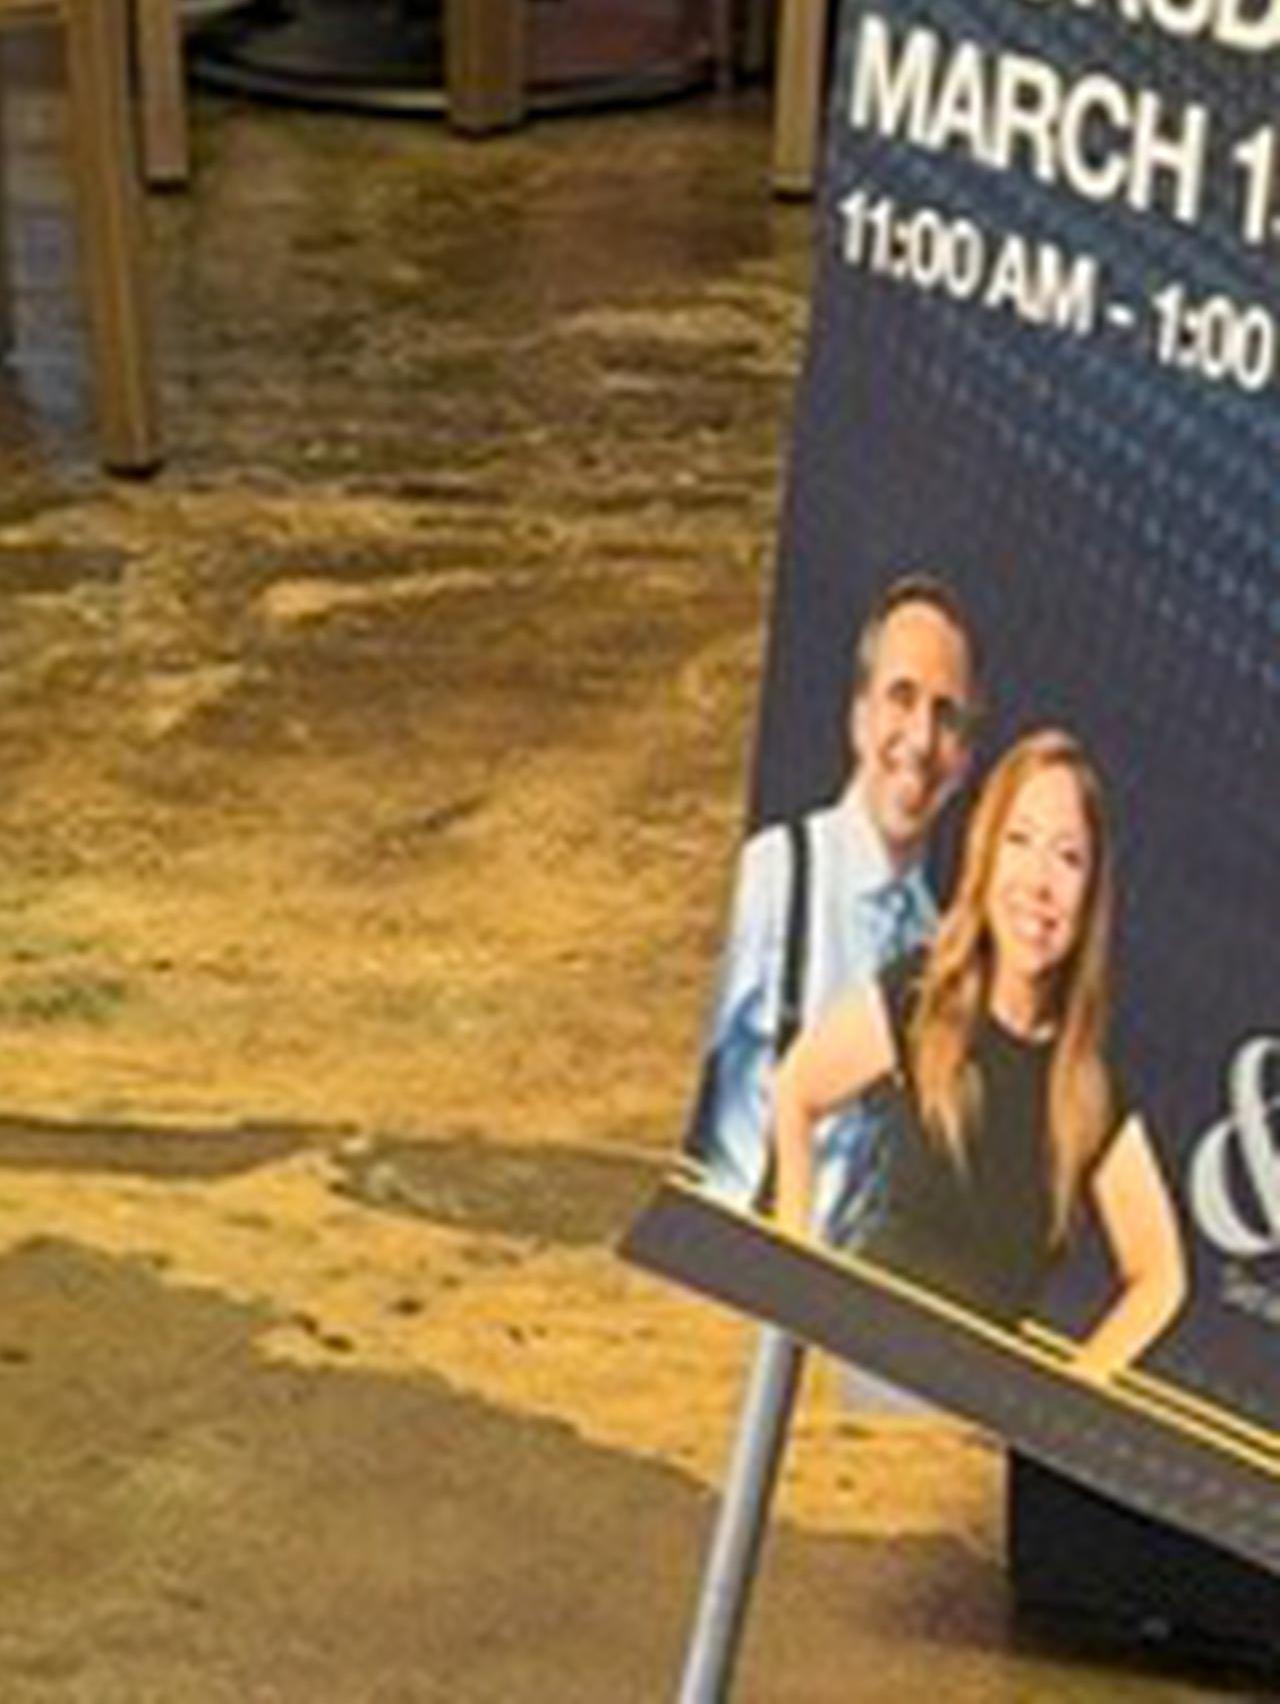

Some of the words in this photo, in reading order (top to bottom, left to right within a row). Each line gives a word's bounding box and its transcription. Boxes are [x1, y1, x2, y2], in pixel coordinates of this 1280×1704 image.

[849, 13, 1208, 224] MARCH
[1232, 125, 1280, 244] 1
[839, 190, 984, 299] 11:00
[982, 233, 1098, 335] AM
[1151, 282, 1274, 391] 1:00
